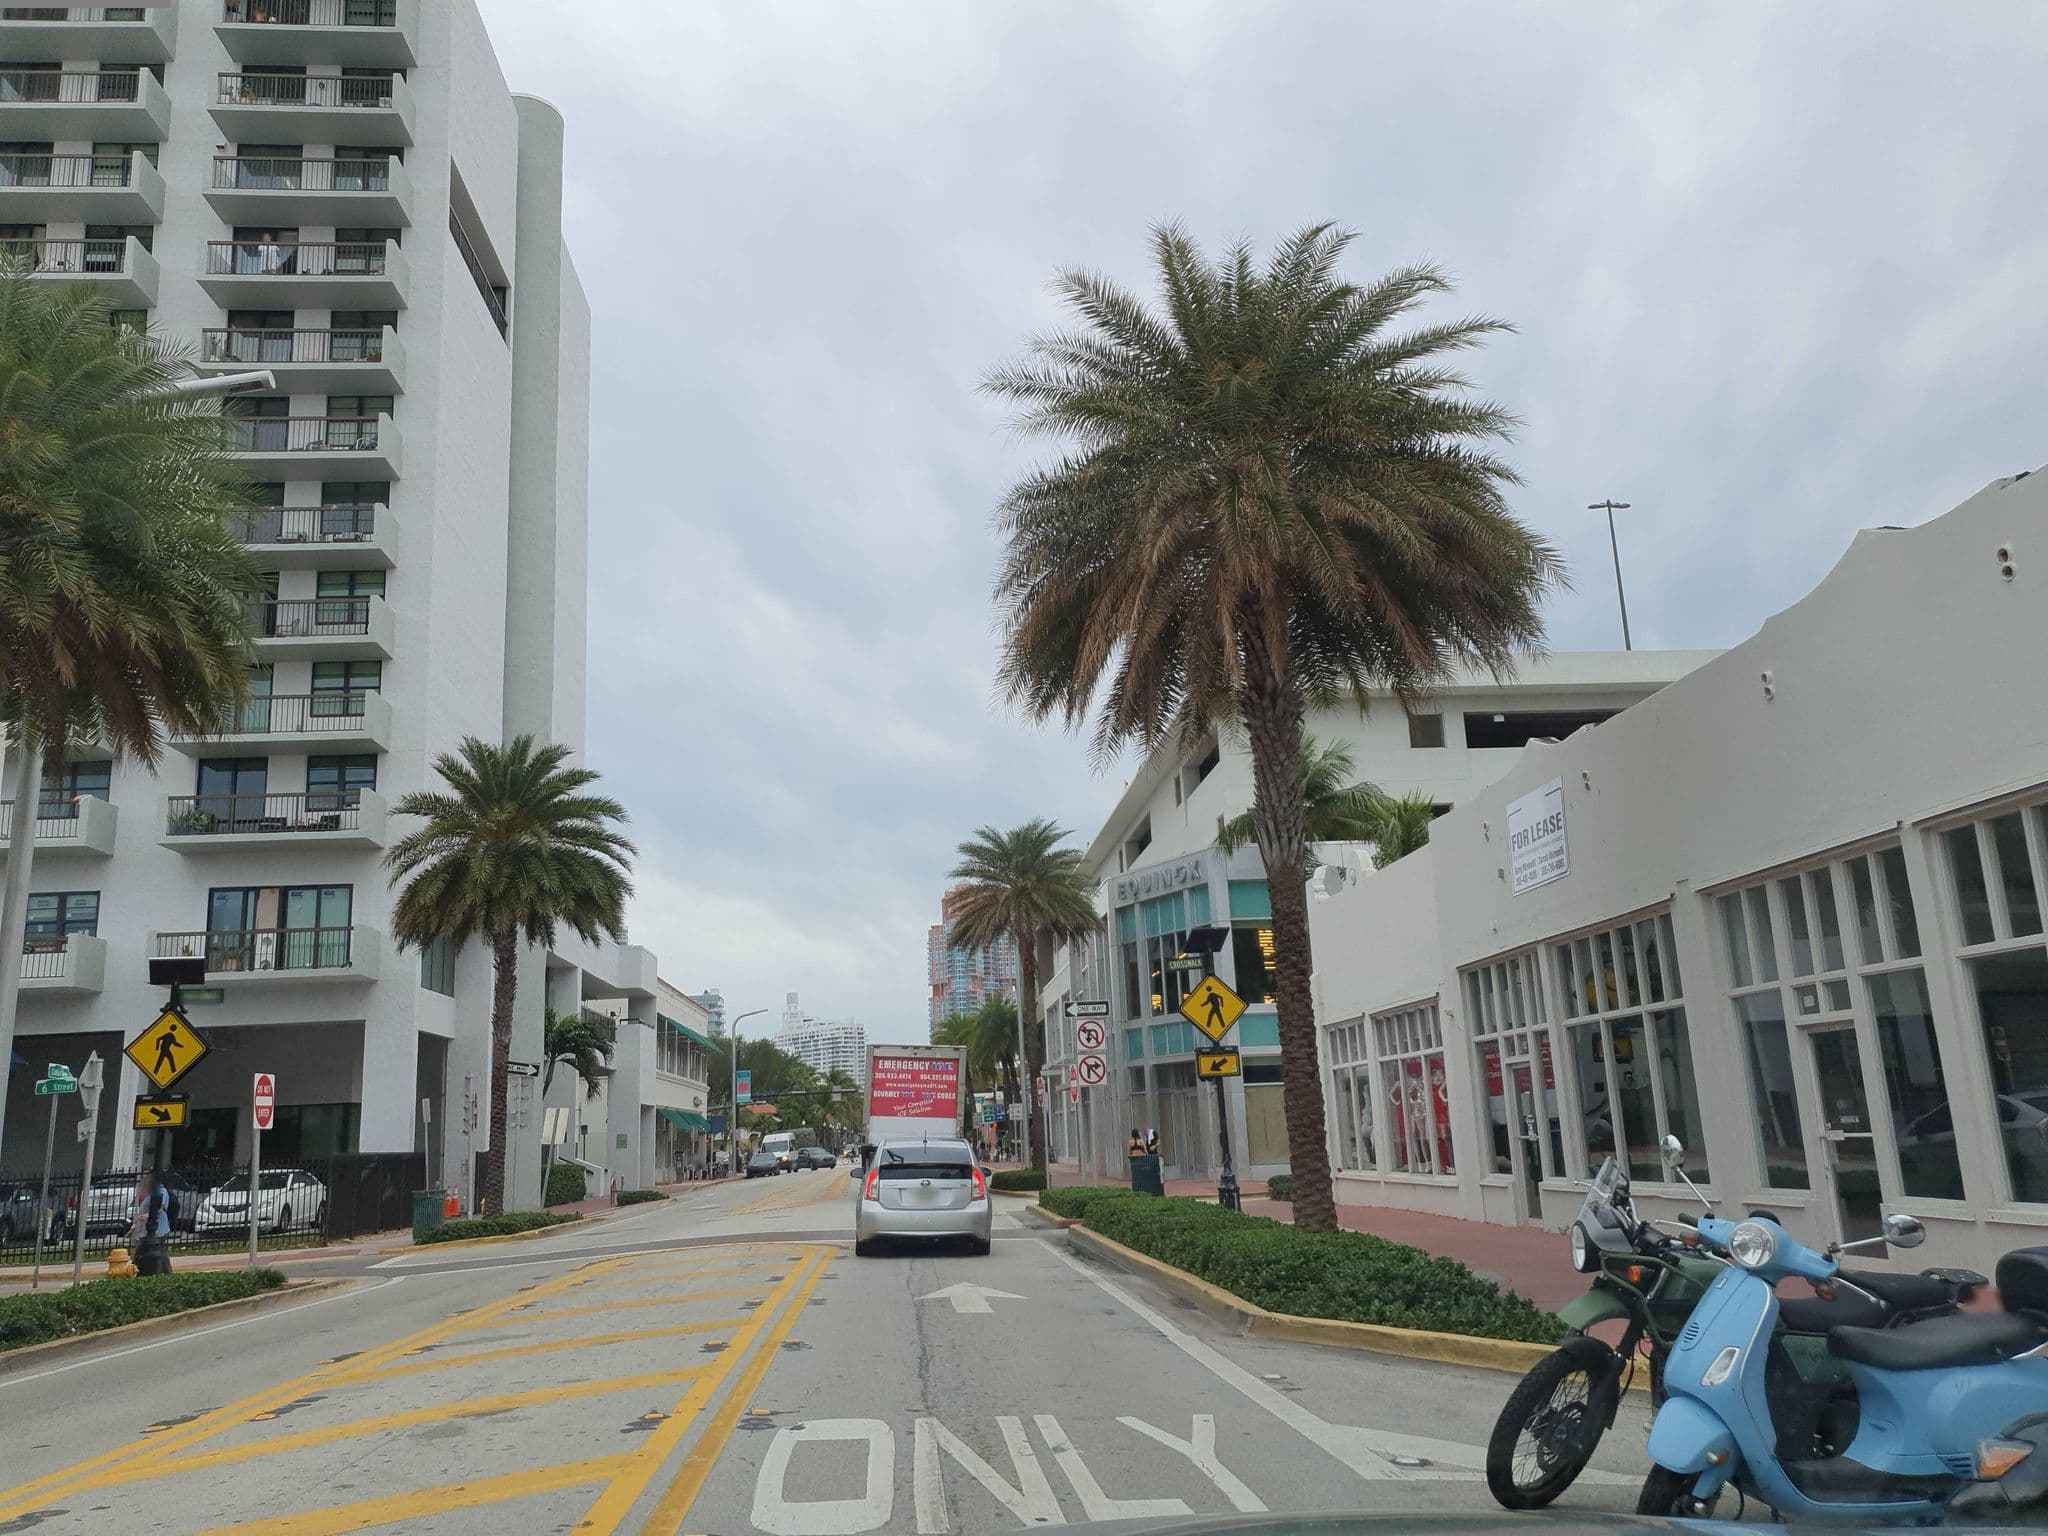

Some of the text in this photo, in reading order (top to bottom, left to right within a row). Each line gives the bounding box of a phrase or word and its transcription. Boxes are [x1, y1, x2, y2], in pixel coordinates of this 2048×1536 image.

[1512, 828, 1530, 852] FOR
[1531, 812, 1563, 843] LEASE
[1119, 860, 1201, 900] EQUINOX
[1169, 959, 1202, 969] CROSSWALK
[1078, 1004, 1106, 1013] ONE WAY
[878, 1060, 929, 1070] EMERGENCY
[42, 1083, 73, 1093] 6 Street
[873, 1090, 900, 1098] GOURMET
[936, 1092, 956, 1100] CUBES
[749, 1413, 1269, 1535] ONLY
